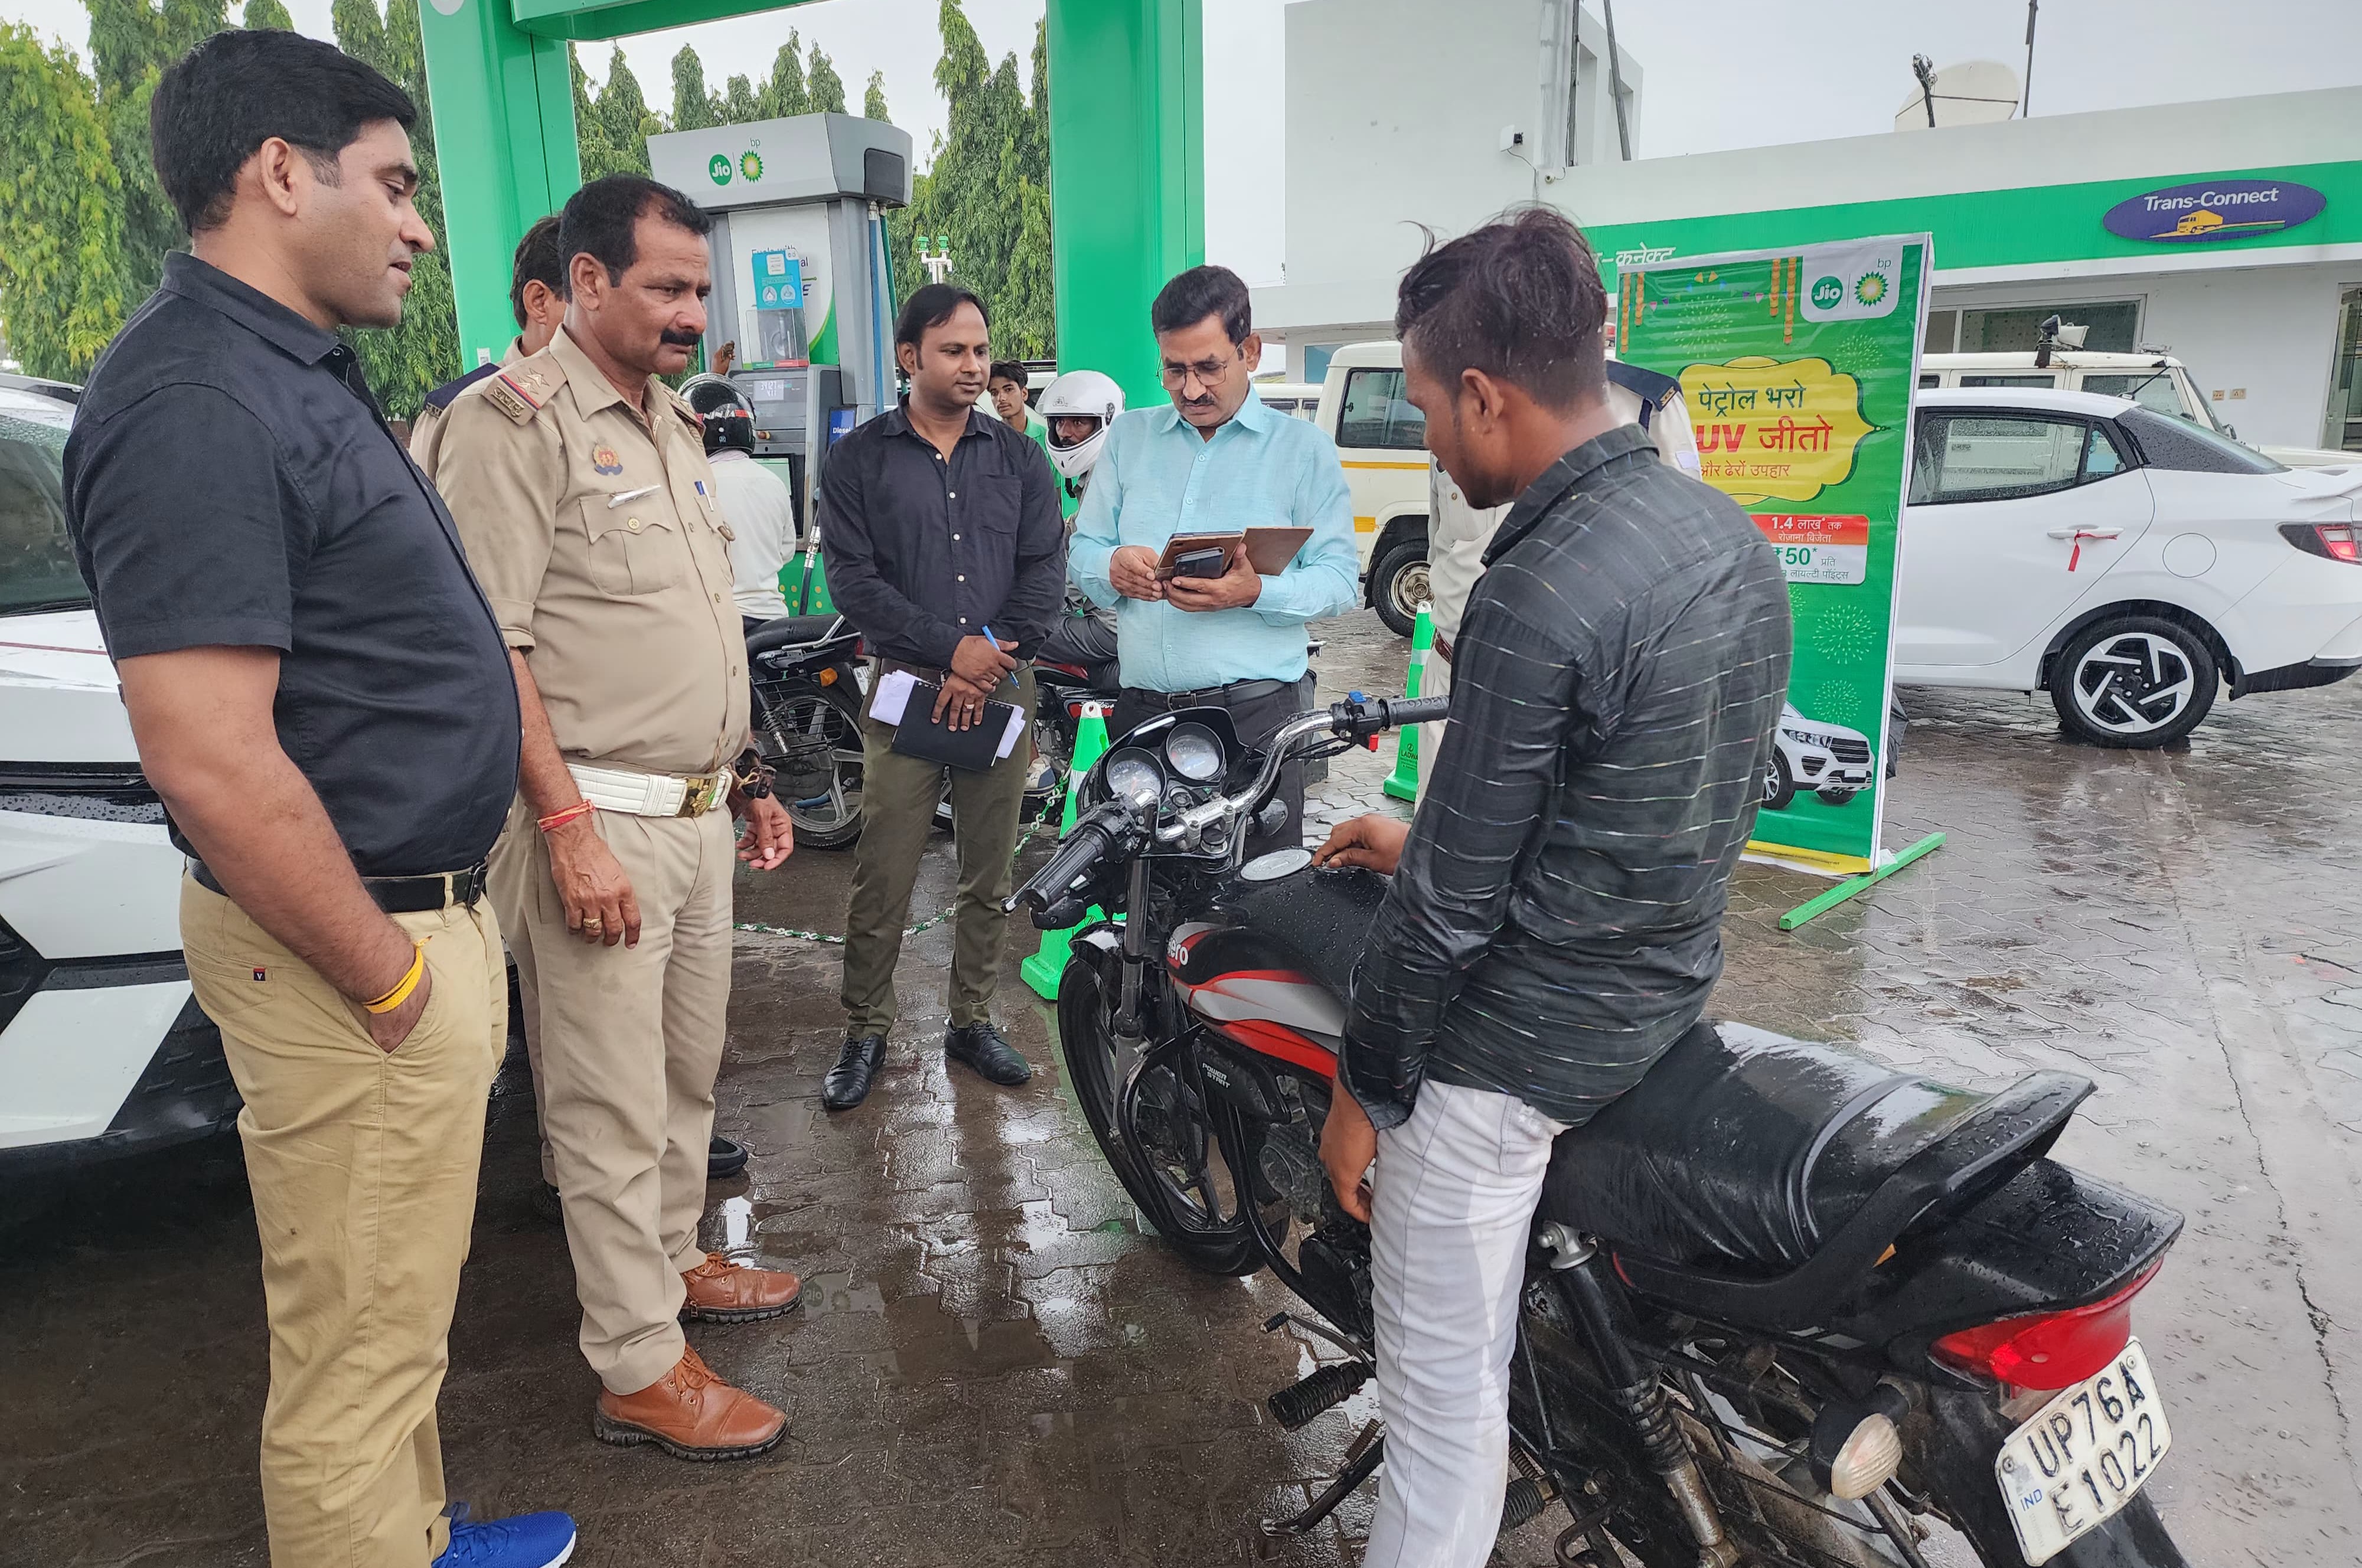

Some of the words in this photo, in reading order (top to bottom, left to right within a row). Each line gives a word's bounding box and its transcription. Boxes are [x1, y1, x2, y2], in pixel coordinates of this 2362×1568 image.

[750, 137, 761, 148] bp
[712, 161, 730, 177] Jio
[2144, 187, 2279, 212] Trans-Connect
[1878, 258, 1891, 270] bp
[1814, 283, 1841, 301] Jio
[1698, 381, 1759, 417] पेट्रोल
[1765, 378, 1807, 409] भरो
[1696, 424, 1747, 454] UV
[1758, 414, 1834, 452] जीतो
[1724, 460, 1746, 477] ढेरों
[1750, 465, 1791, 479] उपहार
[1772, 516, 1793, 530] 1.4
[1827, 522, 1843, 530] तक
[1807, 531, 1832, 543] विजेता
[1821, 556, 1836, 566] प्रति
[1790, 568, 1819, 578] लॉयल्टी
[1202, 1063, 1227, 1081] POWER
[1207, 1072, 1231, 1089] START
[2027, 1360, 2146, 1478] UP76A
[2050, 1412, 2162, 1536] E1022
[2020, 1489, 2043, 1511] IND
